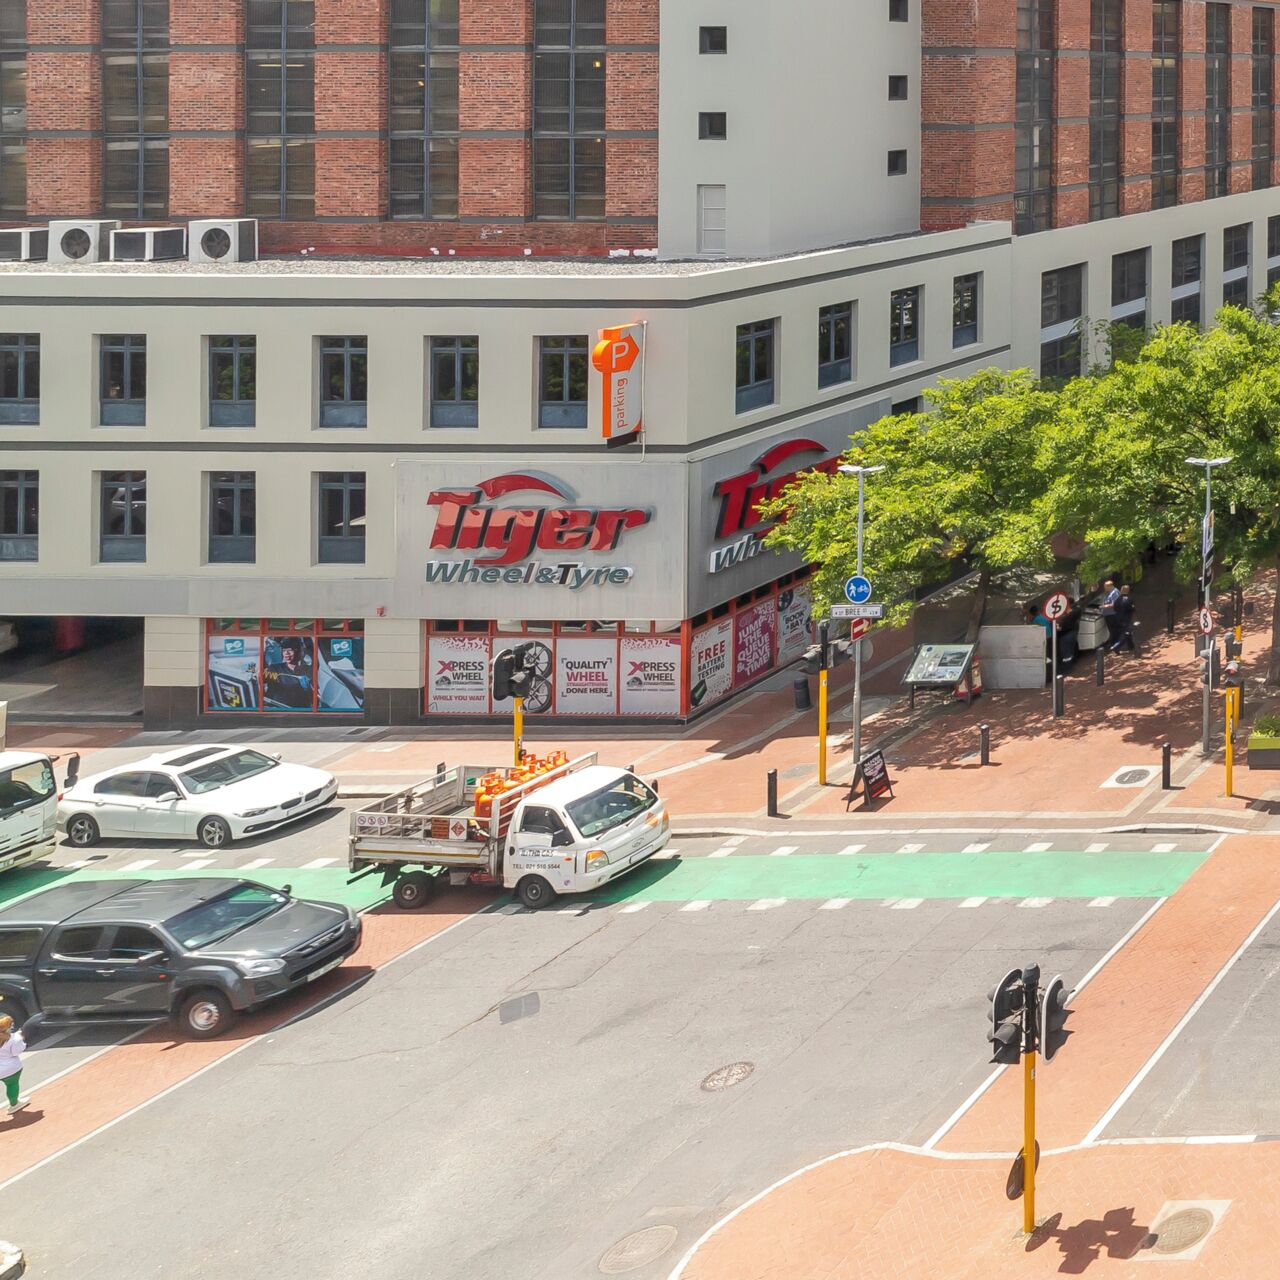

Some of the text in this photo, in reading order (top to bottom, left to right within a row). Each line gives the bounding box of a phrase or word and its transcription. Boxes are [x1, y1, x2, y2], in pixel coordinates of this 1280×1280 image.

[611, 341, 630, 369] P
[613, 378, 628, 428] parking
[426, 486, 652, 566] Tiger
[845, 608, 861, 616] BREE
[739, 616, 764, 645] JUMP
[743, 628, 762, 647] THE
[698, 640, 725, 664] FREE
[737, 632, 770, 661] QUEUE
[435, 660, 484, 675] XPRESS
[565, 661, 608, 671] QUALITY
[627, 660, 676, 676] XPRESS
[698, 654, 725, 672] BATTERY
[698, 662, 725, 680] TESTING
[452, 672, 484, 681] WHEEL
[566, 671, 609, 682] WHEEL
[643, 672, 676, 682] WHEEL
